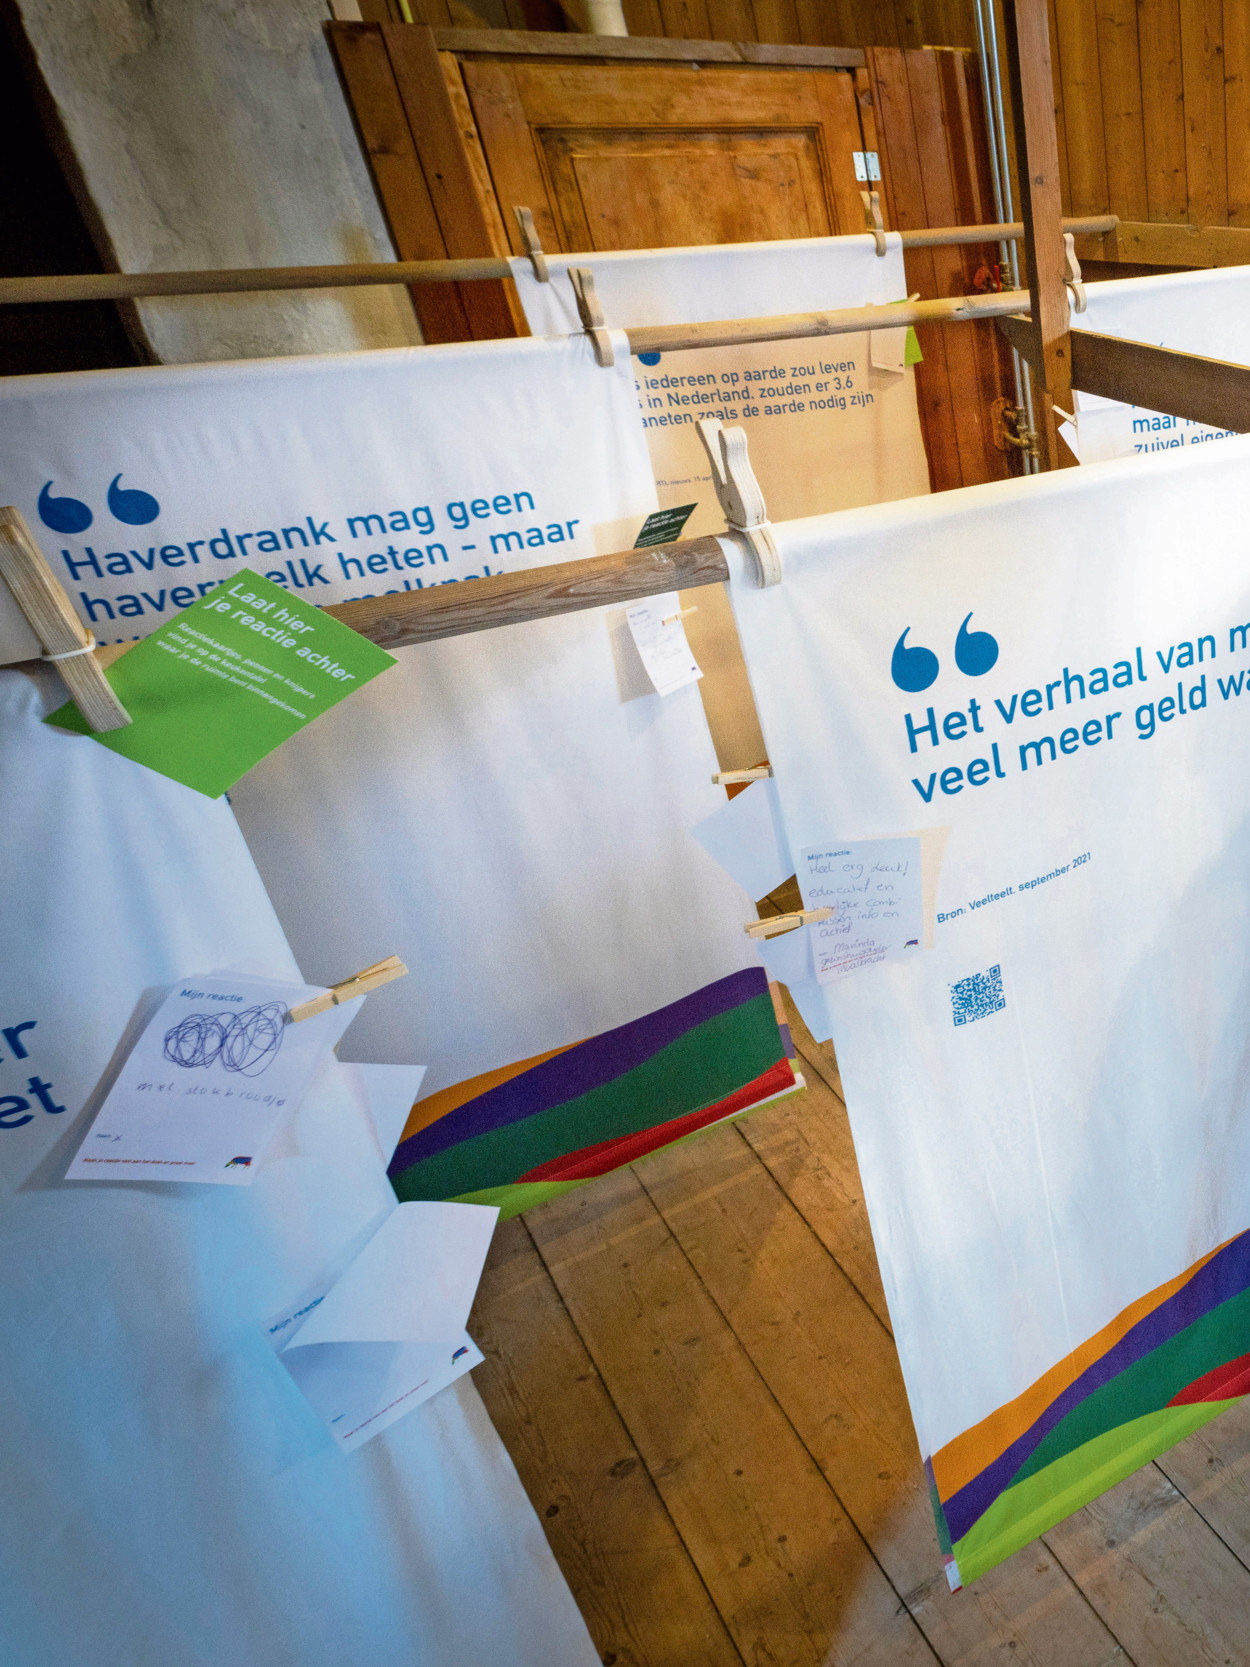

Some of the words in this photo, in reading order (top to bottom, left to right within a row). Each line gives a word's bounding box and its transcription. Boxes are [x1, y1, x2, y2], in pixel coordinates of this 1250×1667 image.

[643, 374, 717, 391] iedereen
[720, 372, 739, 387] op
[743, 365, 786, 382] aarde
[790, 365, 816, 378] zou
[818, 360, 856, 375] leven
[646, 394, 663, 409] in
[758, 382, 812, 399] zouden
[815, 380, 830, 393] er
[642, 412, 694, 428] aneten
[742, 404, 760, 418] de
[763, 399, 806, 416] aarde
[808, 394, 847, 411] nodig
[850, 391, 875, 408] zijn
[61, 516, 339, 582] Haverdrank
[346, 505, 436, 539] mag
[445, 489, 536, 530] geen
[79, 558, 332, 622] haverelk
[337, 540, 449, 581] heten
[489, 519, 580, 555] maar
[227, 583, 276, 615] Laat
[272, 607, 316, 635] hier
[203, 596, 232, 613] je
[230, 608, 297, 650] reactie
[295, 646, 356, 683] achter
[903, 697, 985, 754] Het
[993, 646, 1148, 725] verhaal
[1155, 633, 1217, 675] van
[911, 742, 1007, 804] veel
[1017, 709, 1123, 772] meer
[1133, 674, 1208, 741] geld
[807, 853, 824, 861] Mijn
[825, 849, 851, 858] reactie
[842, 862, 864, 880] erg
[1017, 863, 1071, 892] september
[1072, 851, 1092, 869] 2021
[876, 882, 894, 892] en
[180, 988, 205, 1001] Mijn
[206, 991, 245, 1003] reactie
